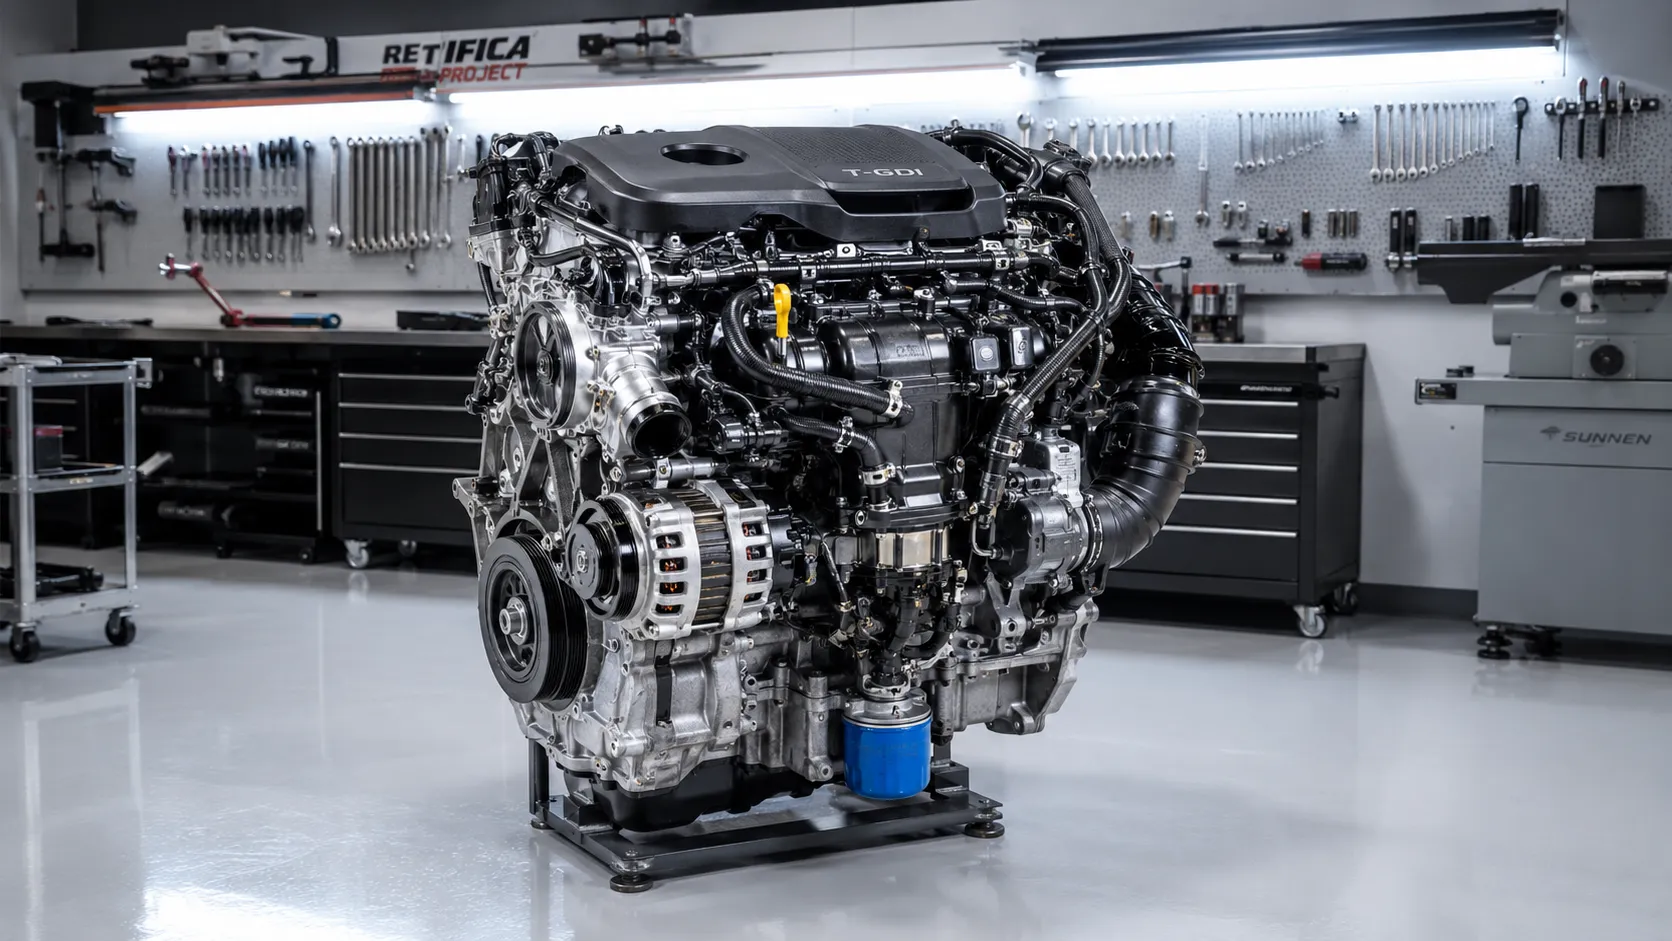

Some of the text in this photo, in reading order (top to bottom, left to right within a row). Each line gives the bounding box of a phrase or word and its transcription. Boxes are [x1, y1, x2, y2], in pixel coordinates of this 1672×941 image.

[437, 62, 528, 83] PROJECT
[842, 168, 924, 177] T-GDI
[1562, 431, 1652, 445] SUNNEN
